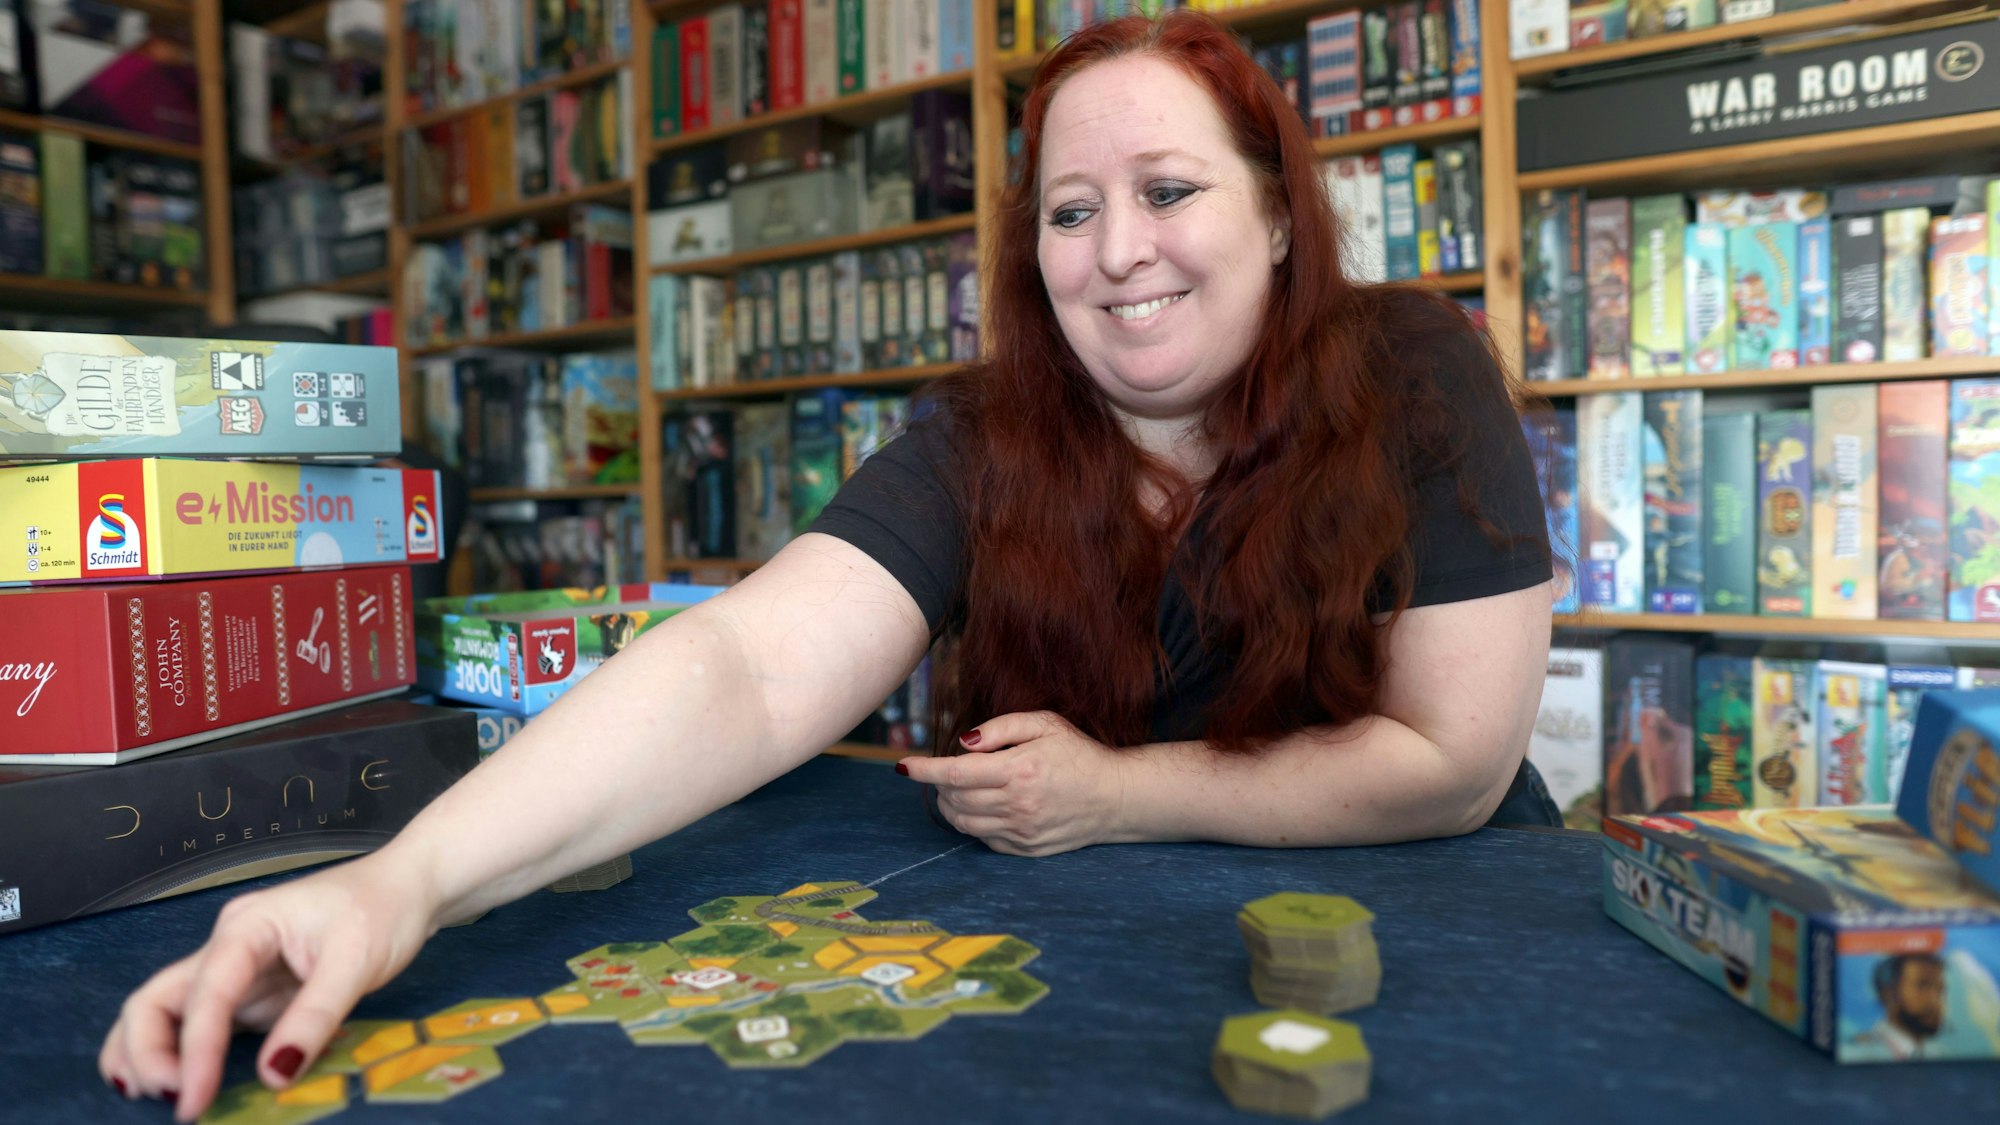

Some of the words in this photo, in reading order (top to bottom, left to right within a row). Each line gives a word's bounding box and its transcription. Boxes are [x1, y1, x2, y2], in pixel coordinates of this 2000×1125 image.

[1686, 73, 1776, 119] WAR
[1799, 48, 1929, 102] ROOM
[1690, 122, 1705, 134] A
[1711, 111, 1772, 130] LARRY
[1781, 97, 1858, 121] HARRIS
[1866, 86, 1929, 108] GAME
[76, 359, 122, 430] GILDE
[122, 359, 144, 432] FAHRENDEN
[142, 365, 166, 424] HÄNDLER
[231, 398, 251, 434] AEG
[26, 475, 49, 483] 49444
[90, 551, 138, 565] Schmidt
[228, 532, 241, 541] DIE
[244, 531, 279, 541] ZUKUNFT
[282, 530, 303, 539] LIEGT
[229, 543, 238, 552] IN
[240, 542, 265, 551] EURER
[267, 541, 289, 550] HAND
[156, 639, 174, 690] JOHN
[169, 616, 185, 707] COMPANY
[455, 659, 503, 697] DORF
[104, 760, 390, 839] DUNE
[160, 808, 356, 856] IMPERIUM
[1611, 860, 1664, 914] SKY
[1667, 885, 1757, 968] TEAM
